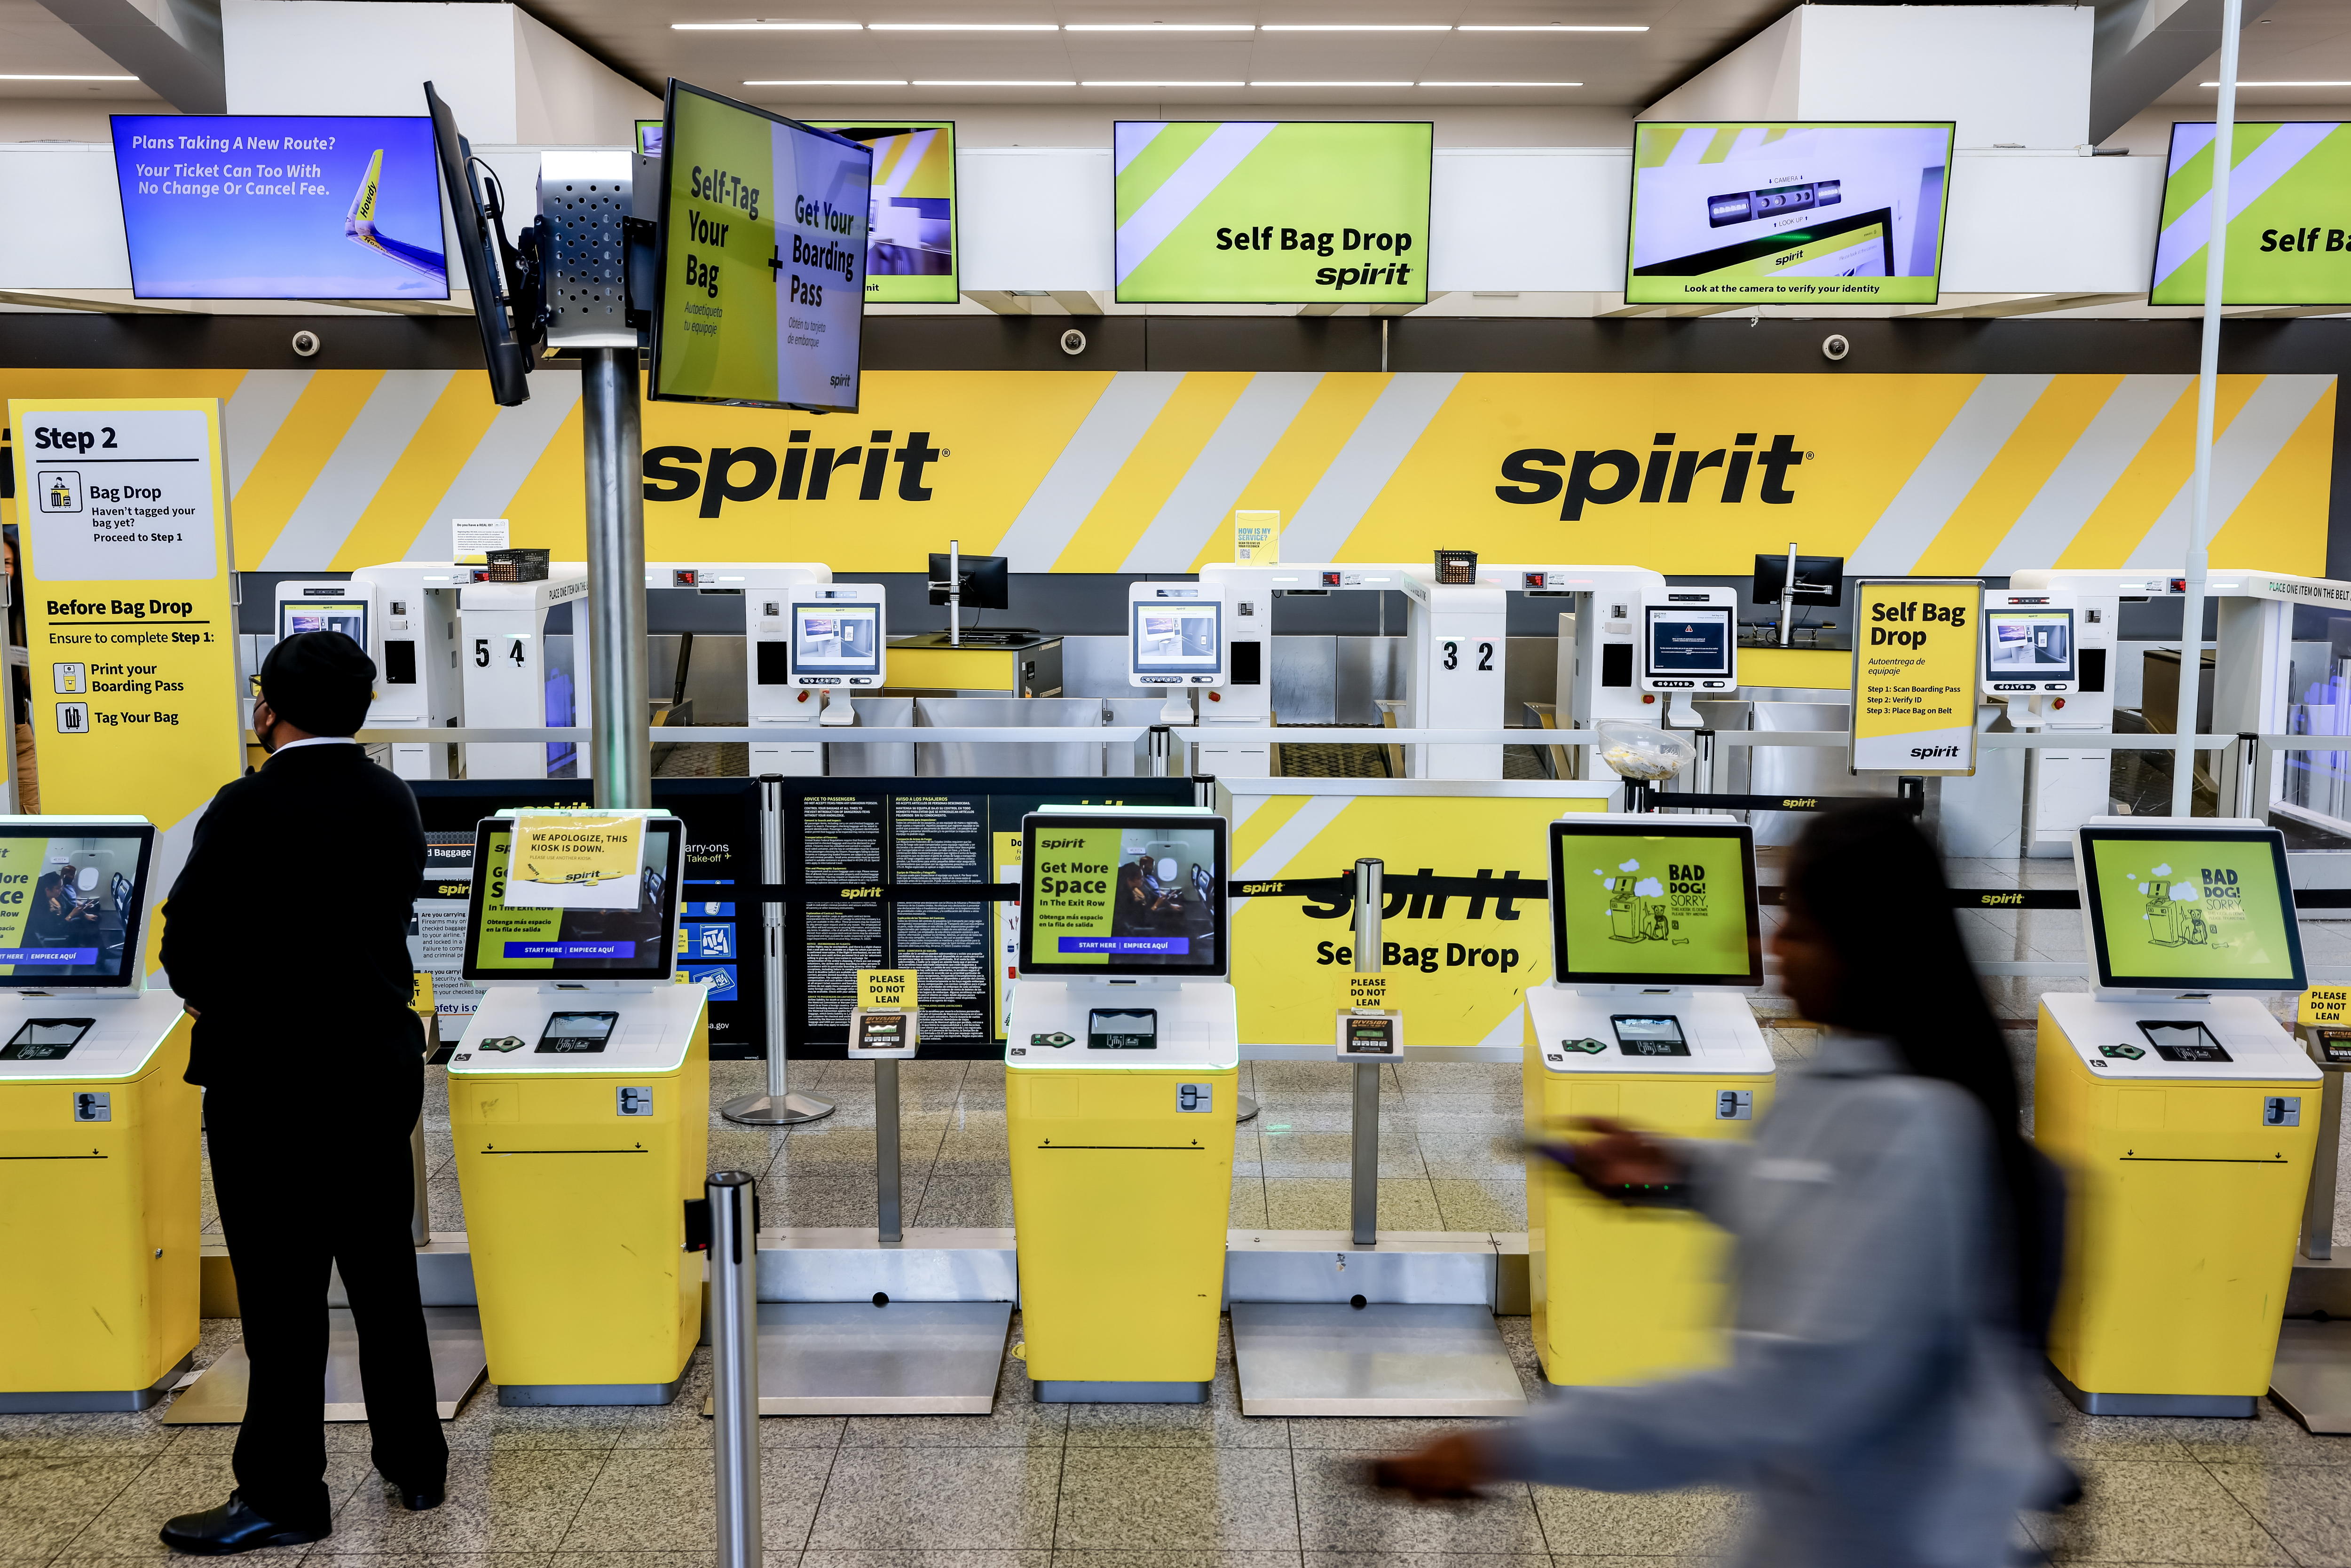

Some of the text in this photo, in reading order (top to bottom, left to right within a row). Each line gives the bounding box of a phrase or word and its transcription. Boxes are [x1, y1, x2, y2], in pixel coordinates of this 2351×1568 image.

[133, 135, 336, 153] Plans Taking A New Route?
[136, 163, 321, 178] Your Ticket Can Too With
[139, 181, 330, 198] No Change Or Cancel Fee.
[690, 165, 759, 221] Self-Tag
[360, 181, 377, 218] Howdy
[795, 194, 854, 236] Get Your
[689, 209, 729, 248] Your
[1216, 226, 1412, 257] Self Bag Drop
[792, 234, 854, 283] Boarding
[1775, 250, 1804, 266] spirit
[686, 254, 719, 299] Bag
[790, 274, 822, 307] Pass
[1788, 284, 1816, 294] verify
[1842, 284, 1880, 294] identity
[684, 301, 723, 319] Autoetiqueta
[684, 320, 717, 337] tu equipaje
[789, 316, 826, 335] Obtén tu tarjeta
[788, 332, 819, 350] de embarque
[830, 373, 851, 389] spirit
[34, 427, 118, 454] Step 2
[90, 486, 161, 503] Bag Drop
[92, 506, 196, 518] Haven’t tagged your
[92, 518, 135, 529] bag yet?
[94, 533, 135, 542] Proceed
[137, 533, 149, 542] to
[151, 533, 174, 544] Step
[2269, 582, 2350, 600] PLACE ONE ITEM ON THE BELT
[47, 599, 193, 618] Before Bag Drop
[1871, 601, 1966, 627] Self Bag
[49, 631, 214, 646] Ensure to complete Step 1:
[1871, 627, 1927, 650] Drop
[474, 639, 524, 667] 5 4
[1443, 642, 1493, 671] 3 2
[91, 662, 157, 678] Print your
[1868, 658, 1915, 667] Autoentrega
[1868, 667, 1901, 676] equipaje
[92, 679, 184, 694] Boarding Pass
[1911, 686, 1944, 694] Boarding
[1892, 696, 1913, 705] Verify
[94, 711, 179, 726] Tag Your Bag
[1910, 746, 1959, 760] spirit
[548, 834, 603, 843] APOLOGIZE,
[1669, 864, 1705, 881] BAD
[841, 887, 881, 899] spirit
[1670, 882, 1705, 894] DOG!
[1671, 894, 1708, 908] SORRY,
